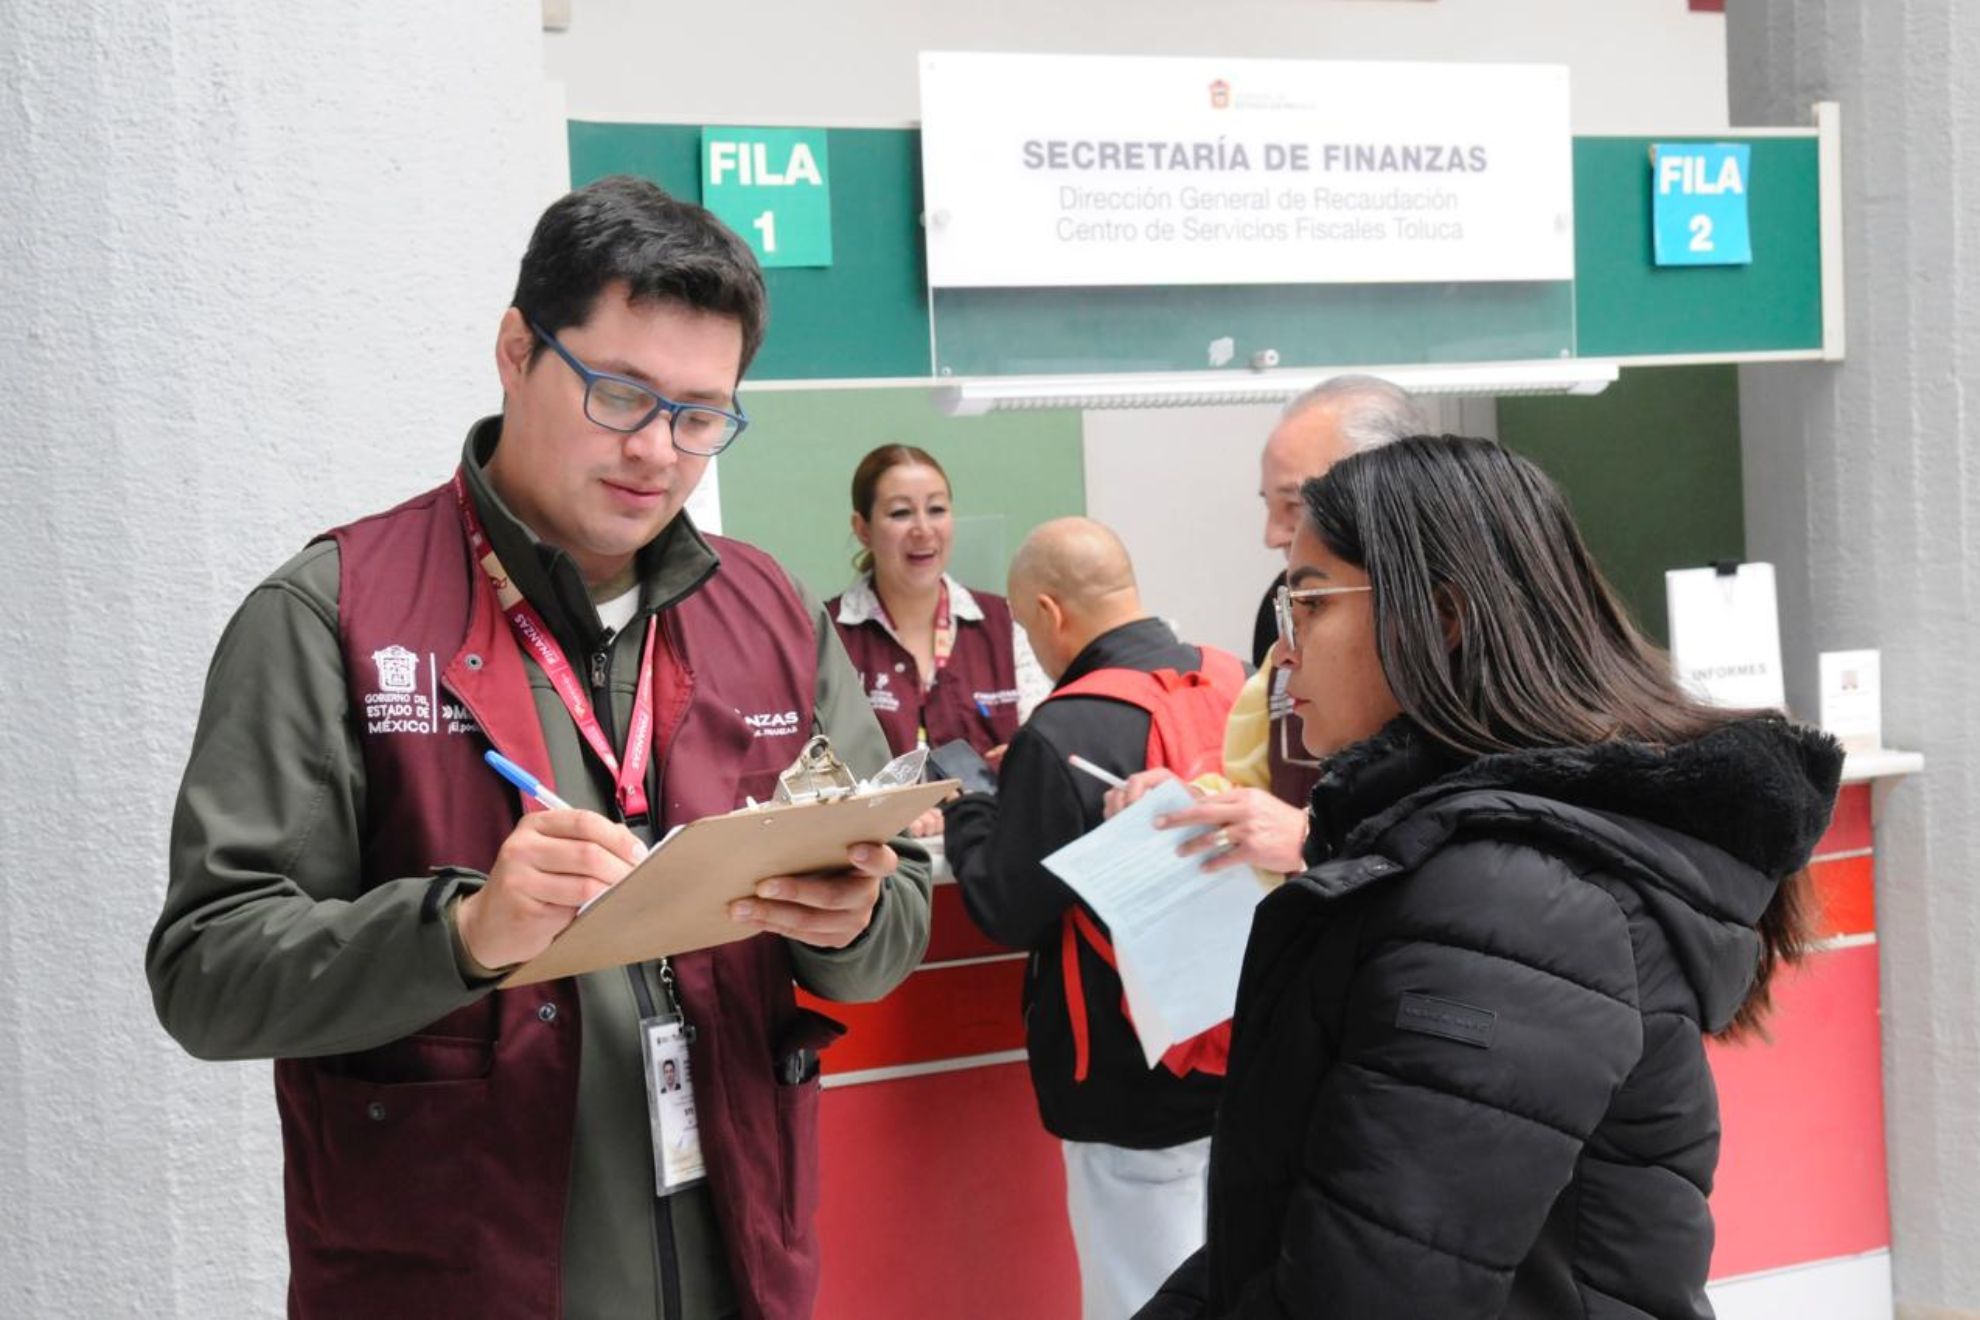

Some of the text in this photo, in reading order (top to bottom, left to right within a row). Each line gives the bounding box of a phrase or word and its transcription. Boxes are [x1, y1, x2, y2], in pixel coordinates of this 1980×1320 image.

[710, 142, 822, 186] FILA
[1022, 136, 1488, 172] SECRETARÍA DE FINANZAS
[1660, 156, 1743, 195] FILA
[1058, 186, 1458, 211] Dirección General de Recaudación
[753, 211, 776, 253] 1
[1056, 216, 1464, 241] Centro de Servicios Fiscales Toluca
[1688, 214, 1716, 252] 2
[514, 613, 560, 664] FINANZAS
[1691, 663, 1766, 681] INFORMES
[365, 694, 410, 704] GOBIERNO
[366, 704, 430, 718] ESTADO DE
[368, 716, 430, 734] MÉXICO
[743, 711, 798, 727] NZAS
